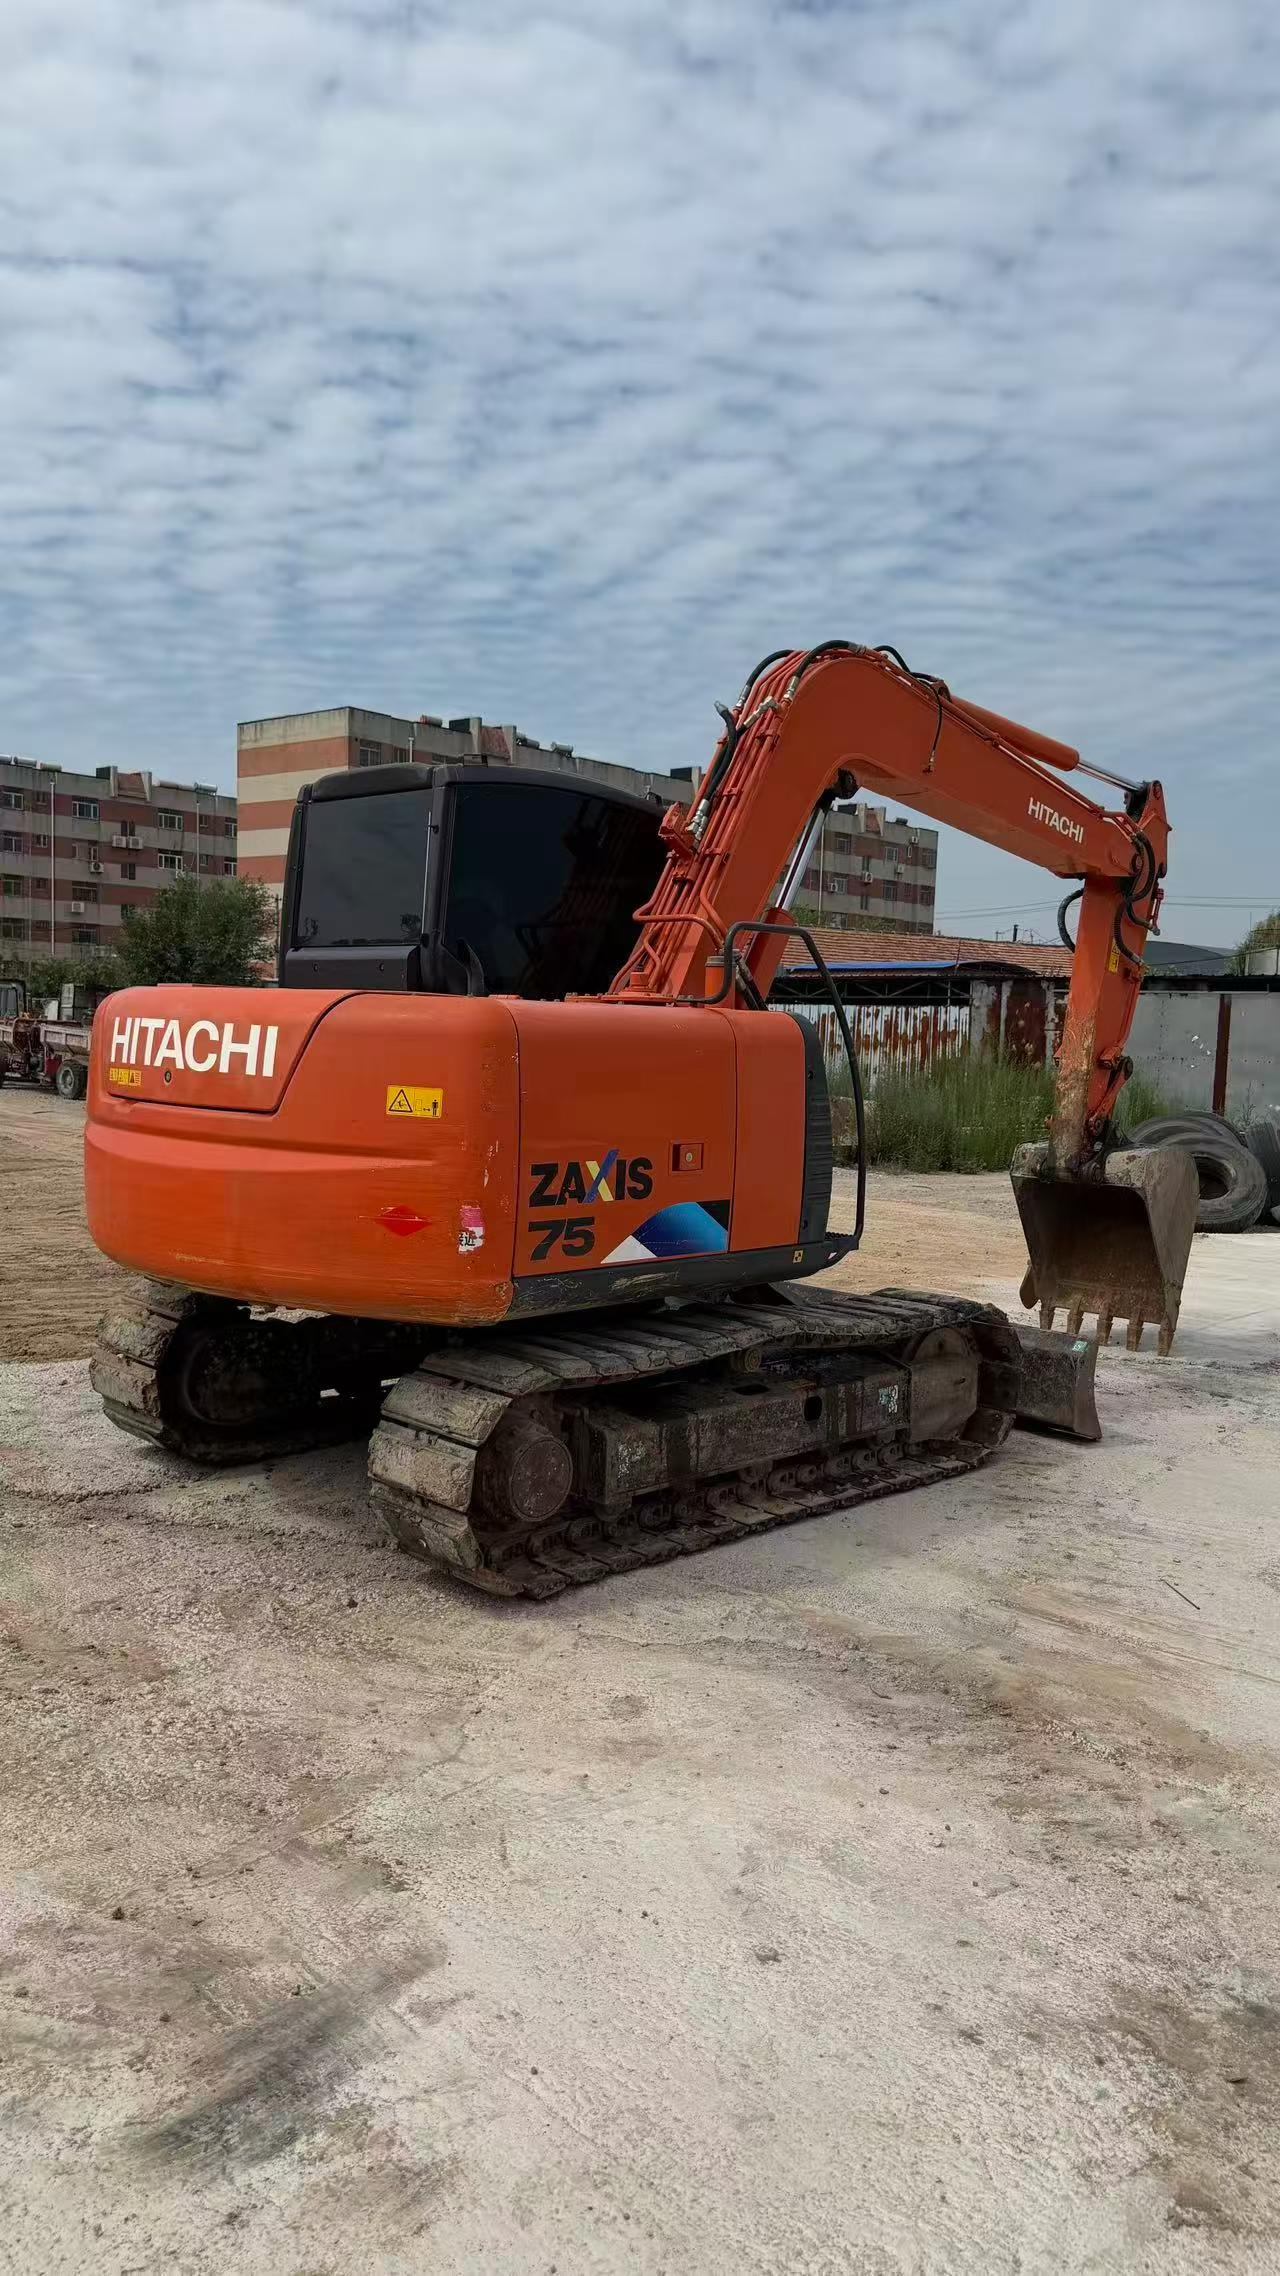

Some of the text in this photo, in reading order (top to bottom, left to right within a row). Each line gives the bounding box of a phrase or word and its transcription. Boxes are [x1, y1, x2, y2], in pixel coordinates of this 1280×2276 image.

[1027, 797, 1083, 843] HITACHI
[110, 1016, 279, 1078] HITACHI
[528, 1148, 653, 1208] ZAXIS
[528, 1216, 596, 1262] 75
